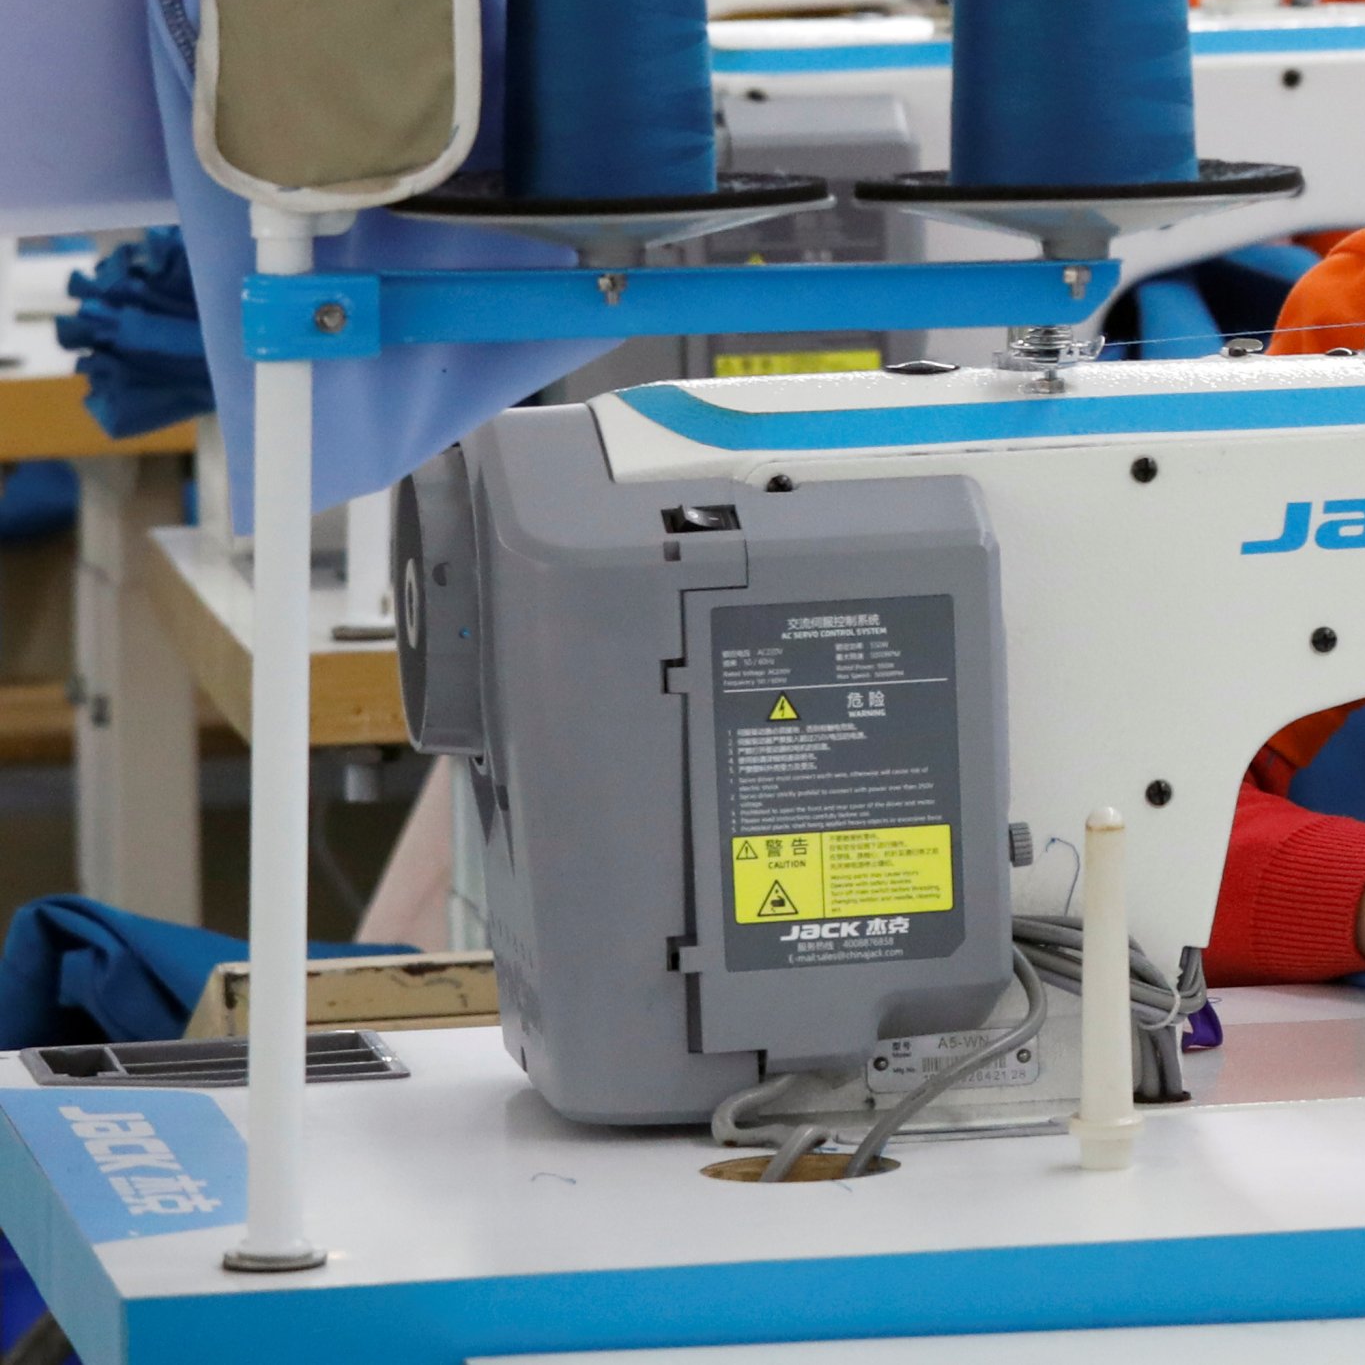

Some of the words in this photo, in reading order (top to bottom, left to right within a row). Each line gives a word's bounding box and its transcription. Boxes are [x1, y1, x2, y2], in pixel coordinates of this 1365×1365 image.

[781, 632, 793, 640] AC
[793, 630, 819, 640] SERVO
[820, 628, 855, 638] CONTROL
[856, 627, 888, 636] SYSTEM
[848, 709, 886, 718] WARNING
[768, 860, 807, 870] CAUTION
[866, 916, 910, 936] 杰克
